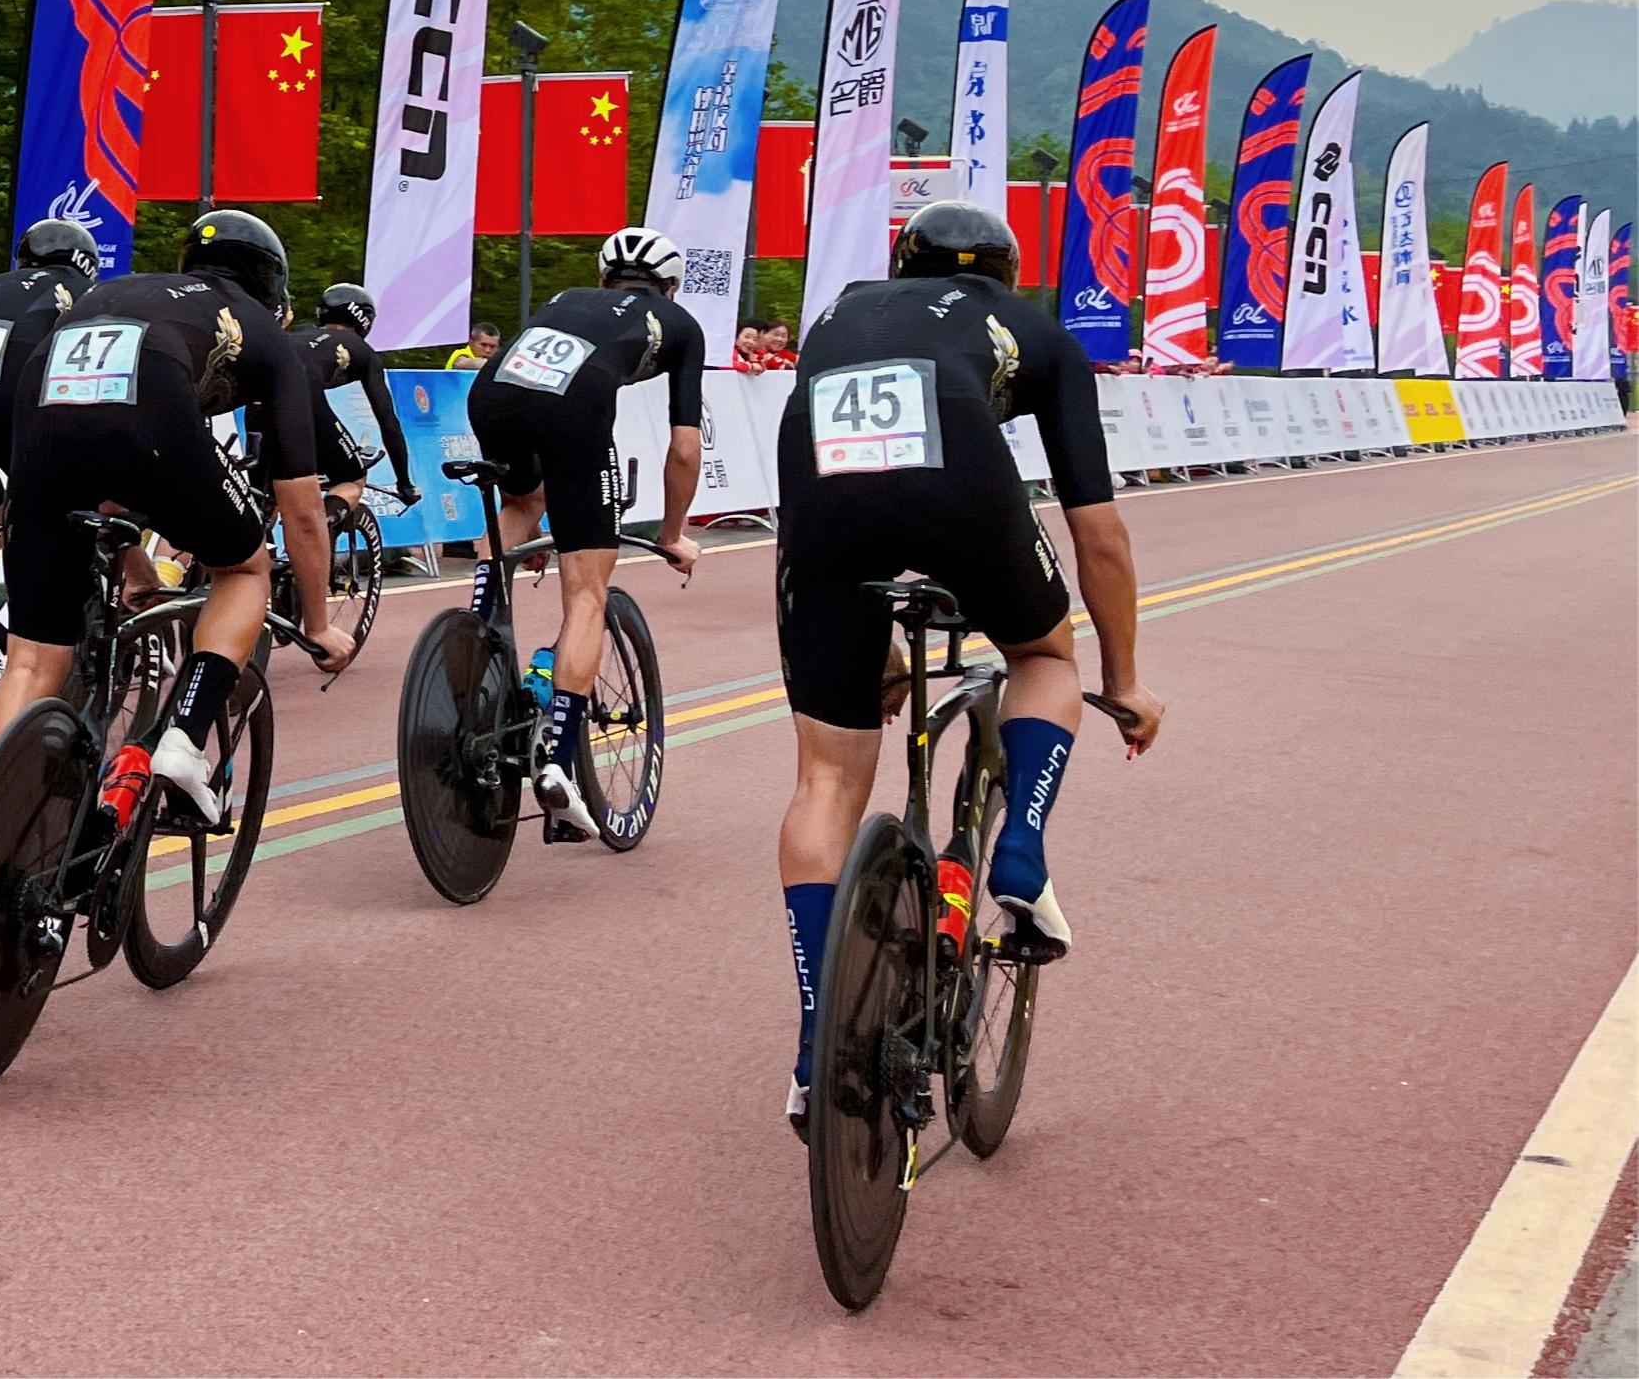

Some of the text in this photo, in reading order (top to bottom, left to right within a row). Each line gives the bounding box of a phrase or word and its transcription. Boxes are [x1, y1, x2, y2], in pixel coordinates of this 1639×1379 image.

[842, 4, 884, 61] MG
[66, 330, 124, 372] 47
[526, 334, 575, 366] 49
[832, 373, 902, 432] 45
[222, 478, 246, 516] CHINA
[600, 470, 611, 505] CHINA
[610, 468, 620, 500] LONG
[1034, 539, 1054, 583] CHINA
[1027, 742, 1067, 831] LI-NING
